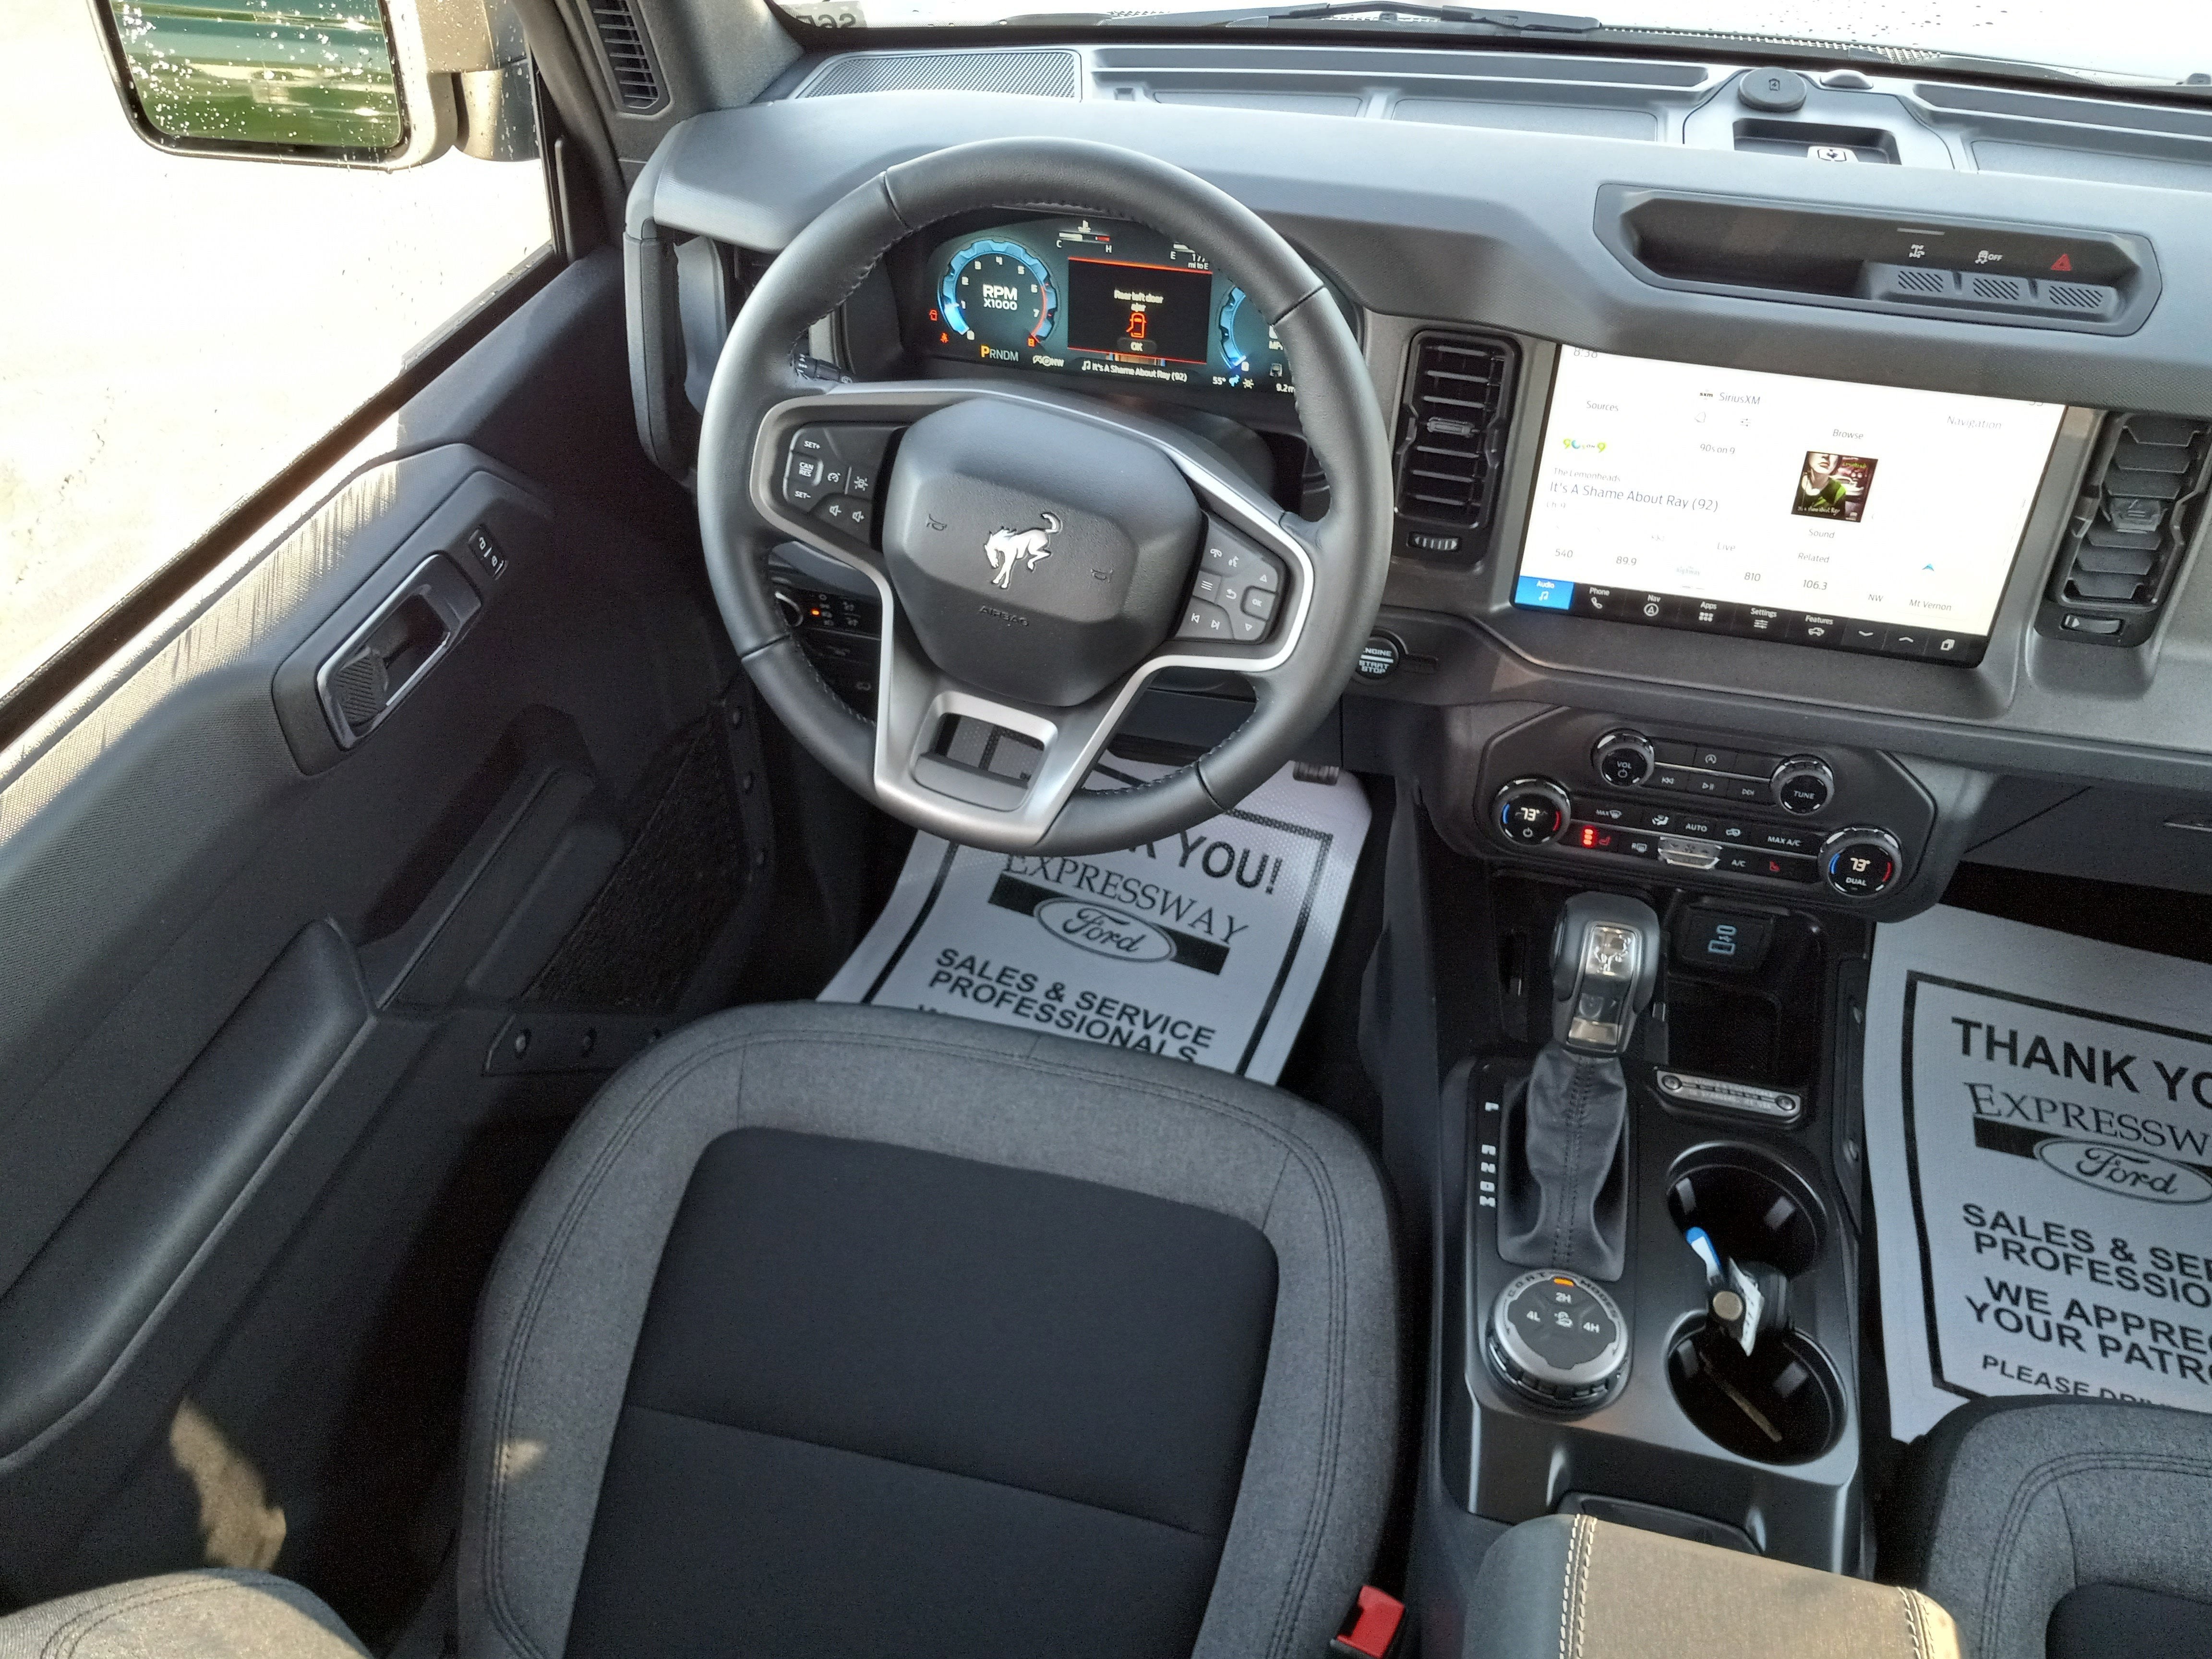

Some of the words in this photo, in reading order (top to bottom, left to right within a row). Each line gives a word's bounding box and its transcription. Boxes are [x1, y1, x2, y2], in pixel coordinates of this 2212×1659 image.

[1057, 240, 1062, 248] C
[1106, 245, 1112, 253] H
[996, 256, 1003, 265] 4
[1170, 251, 1176, 260] E
[1988, 253, 2003, 262] OFF
[974, 261, 981, 270] 3
[1018, 265, 1024, 275] 5
[962, 276, 969, 285] 2
[983, 284, 1018, 301] RPM
[1031, 284, 1038, 293] 6
[1131, 291, 1145, 301] left
[1145, 293, 1164, 303] door
[961, 300, 966, 309] 1
[983, 298, 1018, 311] X1000
[1130, 303, 1146, 312] ajar
[1033, 308, 1040, 318] 7
[966, 330, 974, 340] 0
[1028, 337, 1035, 348] 8
[1130, 342, 1143, 351] OK
[1092, 361, 1104, 372] It's
[1110, 365, 1134, 376] Shame
[1135, 368, 1156, 378] About
[1157, 370, 1171, 381] Ray
[1171, 372, 1188, 382] (92)
[1241, 361, 1249, 372] 0
[1719, 392, 1760, 405] SiriusXM
[1586, 400, 1619, 412] Sources
[1947, 415, 2002, 430] Navigation
[1832, 428, 1864, 440] Browse
[1700, 444, 1715, 454] 90s
[1717, 446, 1728, 455] on
[1729, 446, 1736, 455] 9
[799, 462, 814, 470] CAN
[1553, 467, 1568, 476] The
[1570, 469, 1621, 482] Lemonheads
[1550, 481, 1568, 493] It's
[1571, 484, 1579, 495] A
[1582, 485, 1624, 500] Shame
[1626, 491, 1663, 505] About
[1666, 495, 1689, 509] Ray
[1692, 498, 1719, 513] (92)
[1808, 528, 1835, 539] Sound
[1717, 542, 1736, 551] Live
[1554, 548, 1574, 559] 540
[1616, 555, 1637, 566] 89.9
[1798, 552, 1830, 564] Related
[1536, 580, 1555, 590] Audio
[1744, 572, 1761, 582] 810
[1803, 579, 1828, 591] 106.3
[1589, 587, 1610, 597] Phone
[1251, 598, 1262, 607] OK
[1647, 594, 1661, 603] Nav
[1868, 594, 1884, 603] NW
[1700, 601, 1717, 611] Apps
[1909, 599, 1921, 608] Mt
[1923, 601, 1952, 612] Vernon
[980, 604, 1029, 626] AIRBAG
[1750, 608, 1778, 619] Settings
[1805, 615, 1834, 626] Features
[1363, 647, 1392, 657] NGINE
[1359, 660, 1390, 670] START
[1361, 665, 1386, 674] STOP
[1793, 790, 1815, 800] TUNE
[1685, 823, 1707, 833] AUTO
[1767, 836, 1785, 846] MAX
[1786, 838, 1801, 847] A/C
[1178, 830, 1283, 895] YOU!
[1731, 859, 1746, 868] A/C
[1845, 876, 1867, 887] DUAL
[1002, 855, 1249, 945] EXPRESSWAY
[1062, 907, 1147, 952] Ford
[937, 948, 1039, 993] SALES
[1044, 982, 1065, 1001] &
[1074, 990, 1216, 1048] SERVICE
[928, 972, 1197, 1063] PROFESSIONALS
[1951, 1016, 2140, 1094] THANK
[2076, 1147, 2177, 1195] Ford
[1962, 1202, 2094, 1253] SALES
[2110, 1238, 2137, 1264] &
[1973, 1230, 2212, 1308] PROFESSIO
[1556, 1292, 1572, 1304] 2H
[1526, 1310, 1541, 1322] 4L
[1984, 1276, 2051, 1315] WE
[2064, 1298, 2212, 1355] APPRE
[1584, 1322, 1600, 1334] 4H
[1965, 1296, 2087, 1353] YOUR
[2098, 1334, 2212, 1385] PATR
[1983, 1355, 2090, 1395] PLEASE
